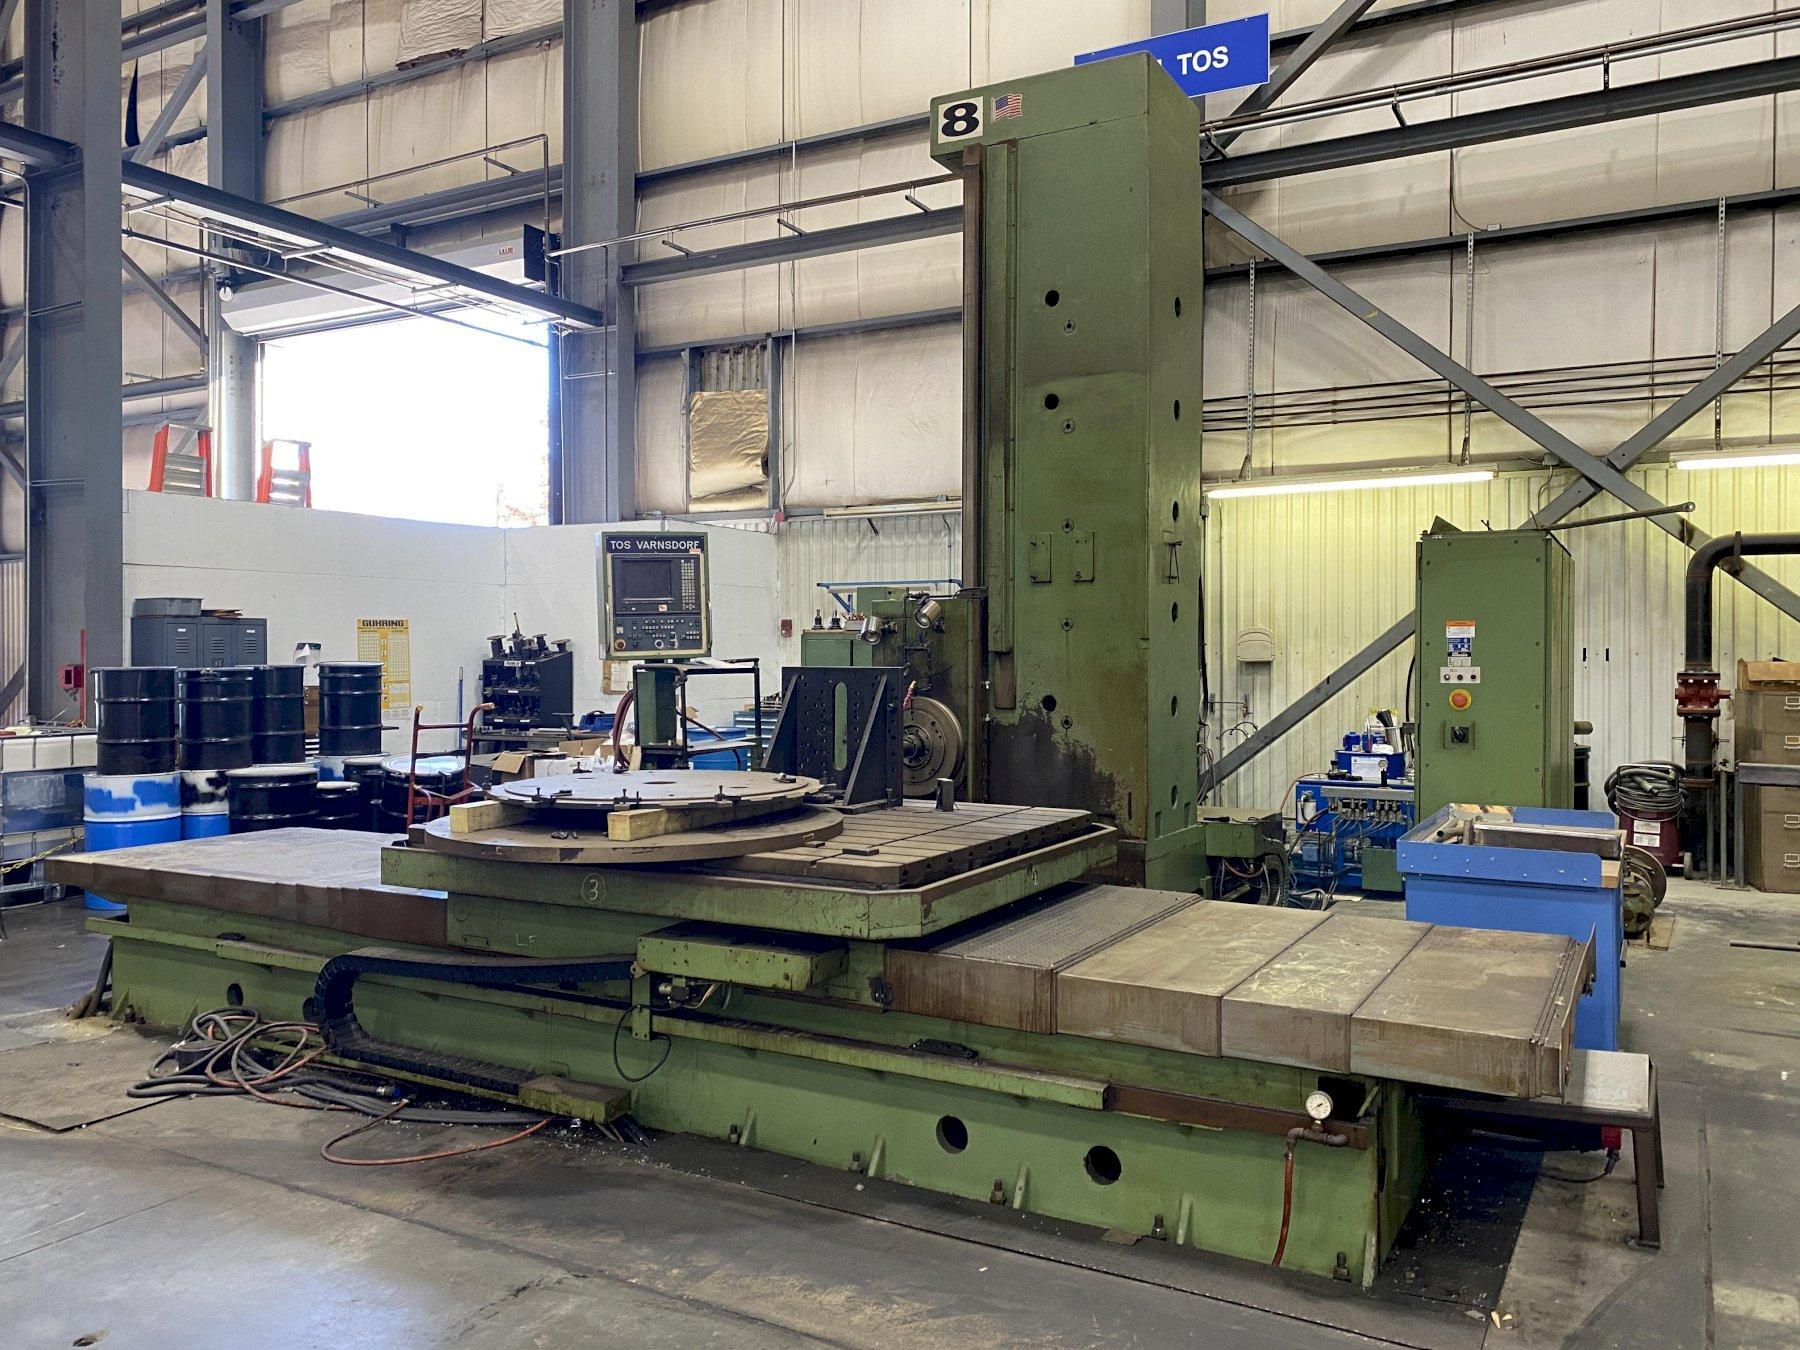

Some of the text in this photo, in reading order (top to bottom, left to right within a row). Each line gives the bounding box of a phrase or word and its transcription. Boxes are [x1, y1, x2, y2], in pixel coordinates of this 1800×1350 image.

[1177, 46, 1229, 75] TOS
[941, 102, 980, 137] 8
[610, 540, 700, 550] TOS VARNSDORF
[589, 879, 599, 900] 3
